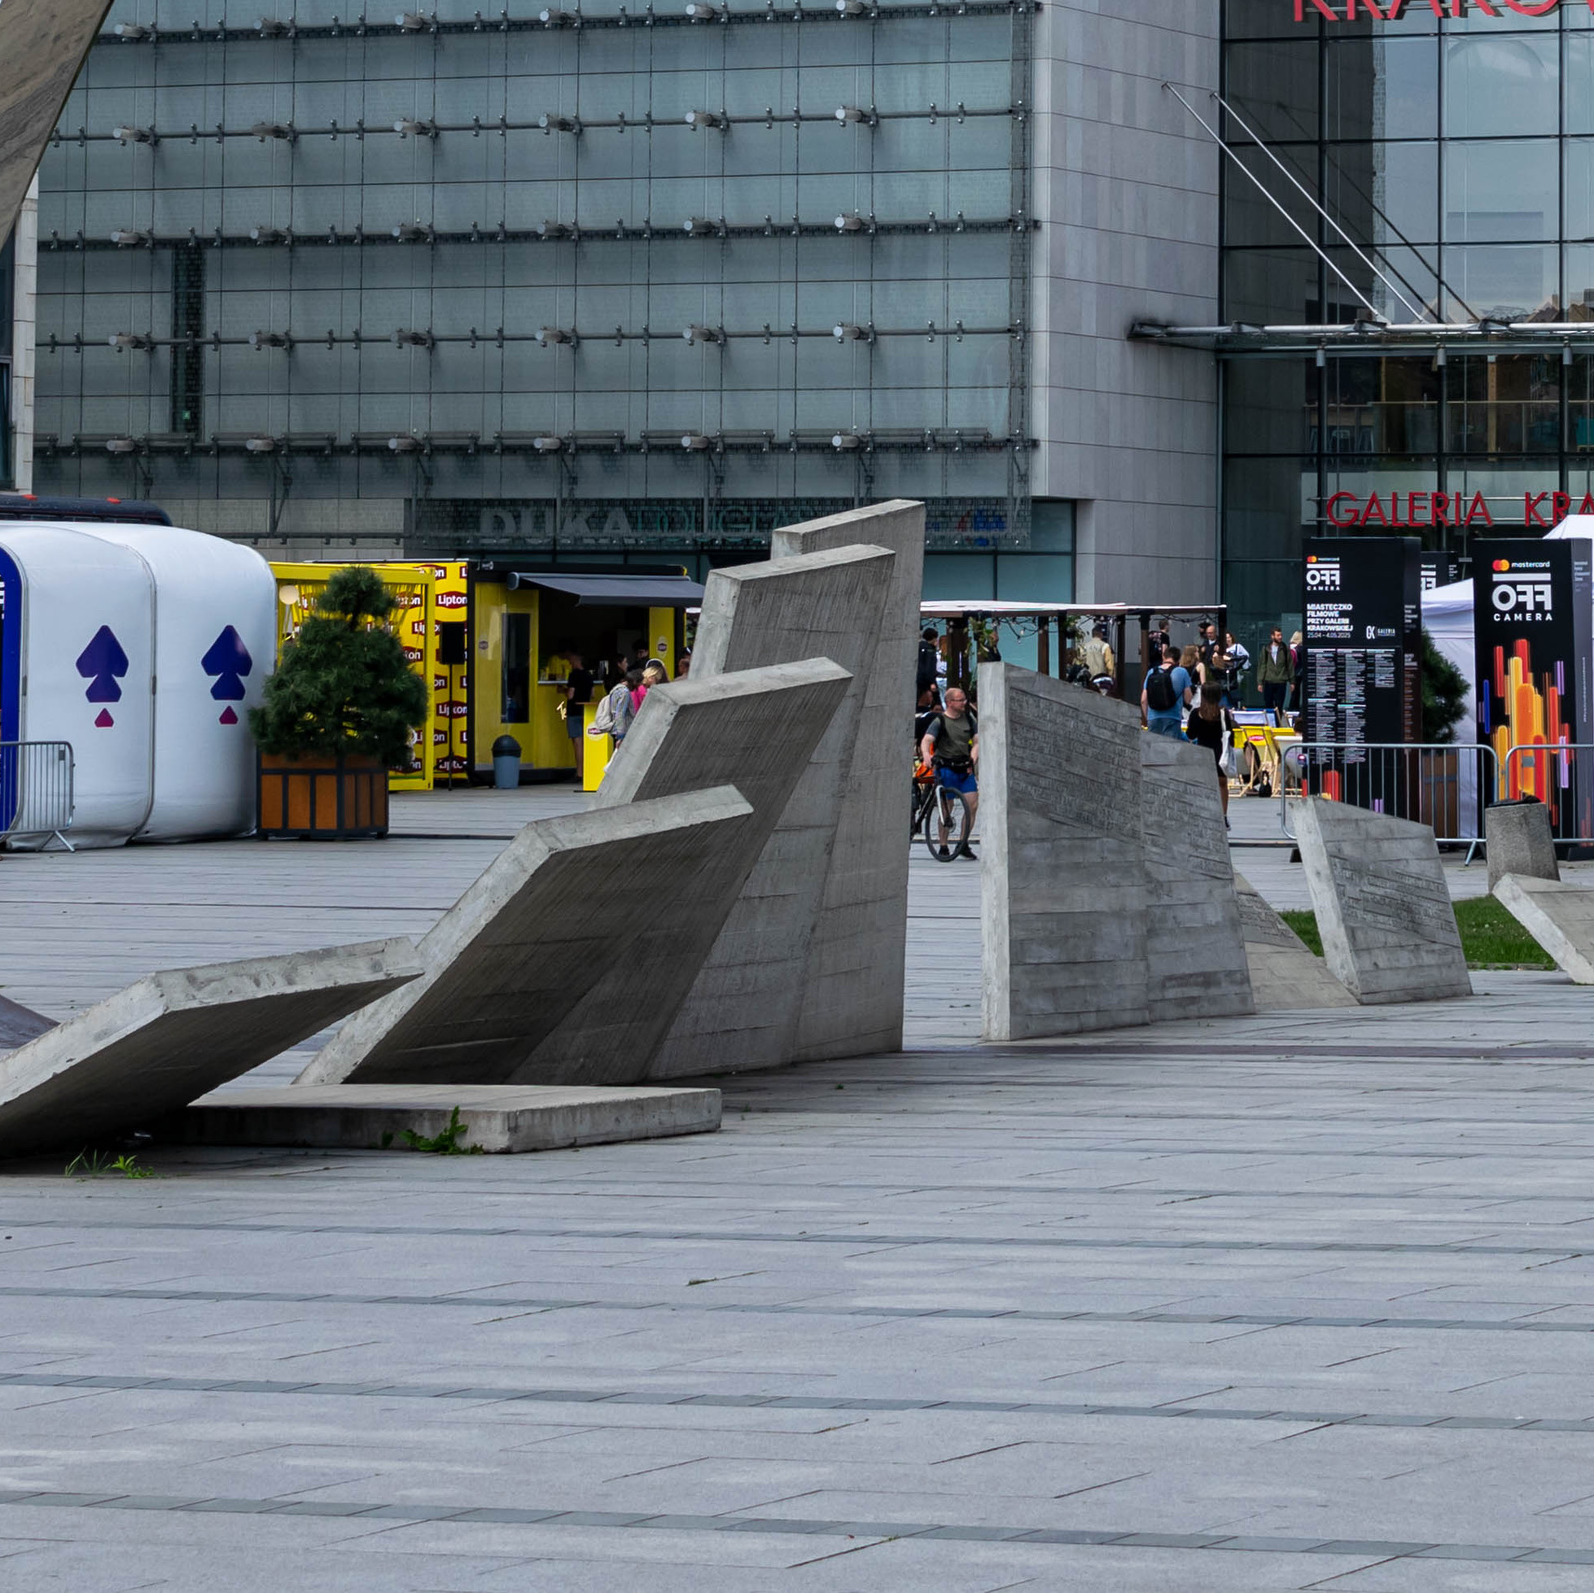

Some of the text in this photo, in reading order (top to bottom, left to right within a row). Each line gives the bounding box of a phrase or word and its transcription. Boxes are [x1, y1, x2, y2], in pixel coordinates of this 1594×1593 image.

[1327, 490, 1493, 528] GALERIA
[479, 507, 815, 545] DUKA DOUGL
[1511, 560, 1550, 569] mastercard
[1306, 570, 1341, 586] OFF
[437, 594, 468, 607] Lipton
[1492, 584, 1553, 612] OFF
[1307, 603, 1354, 611] MIASTECZKO
[1493, 613, 1553, 622] CAMERA
[416, 731, 446, 742] Lion
